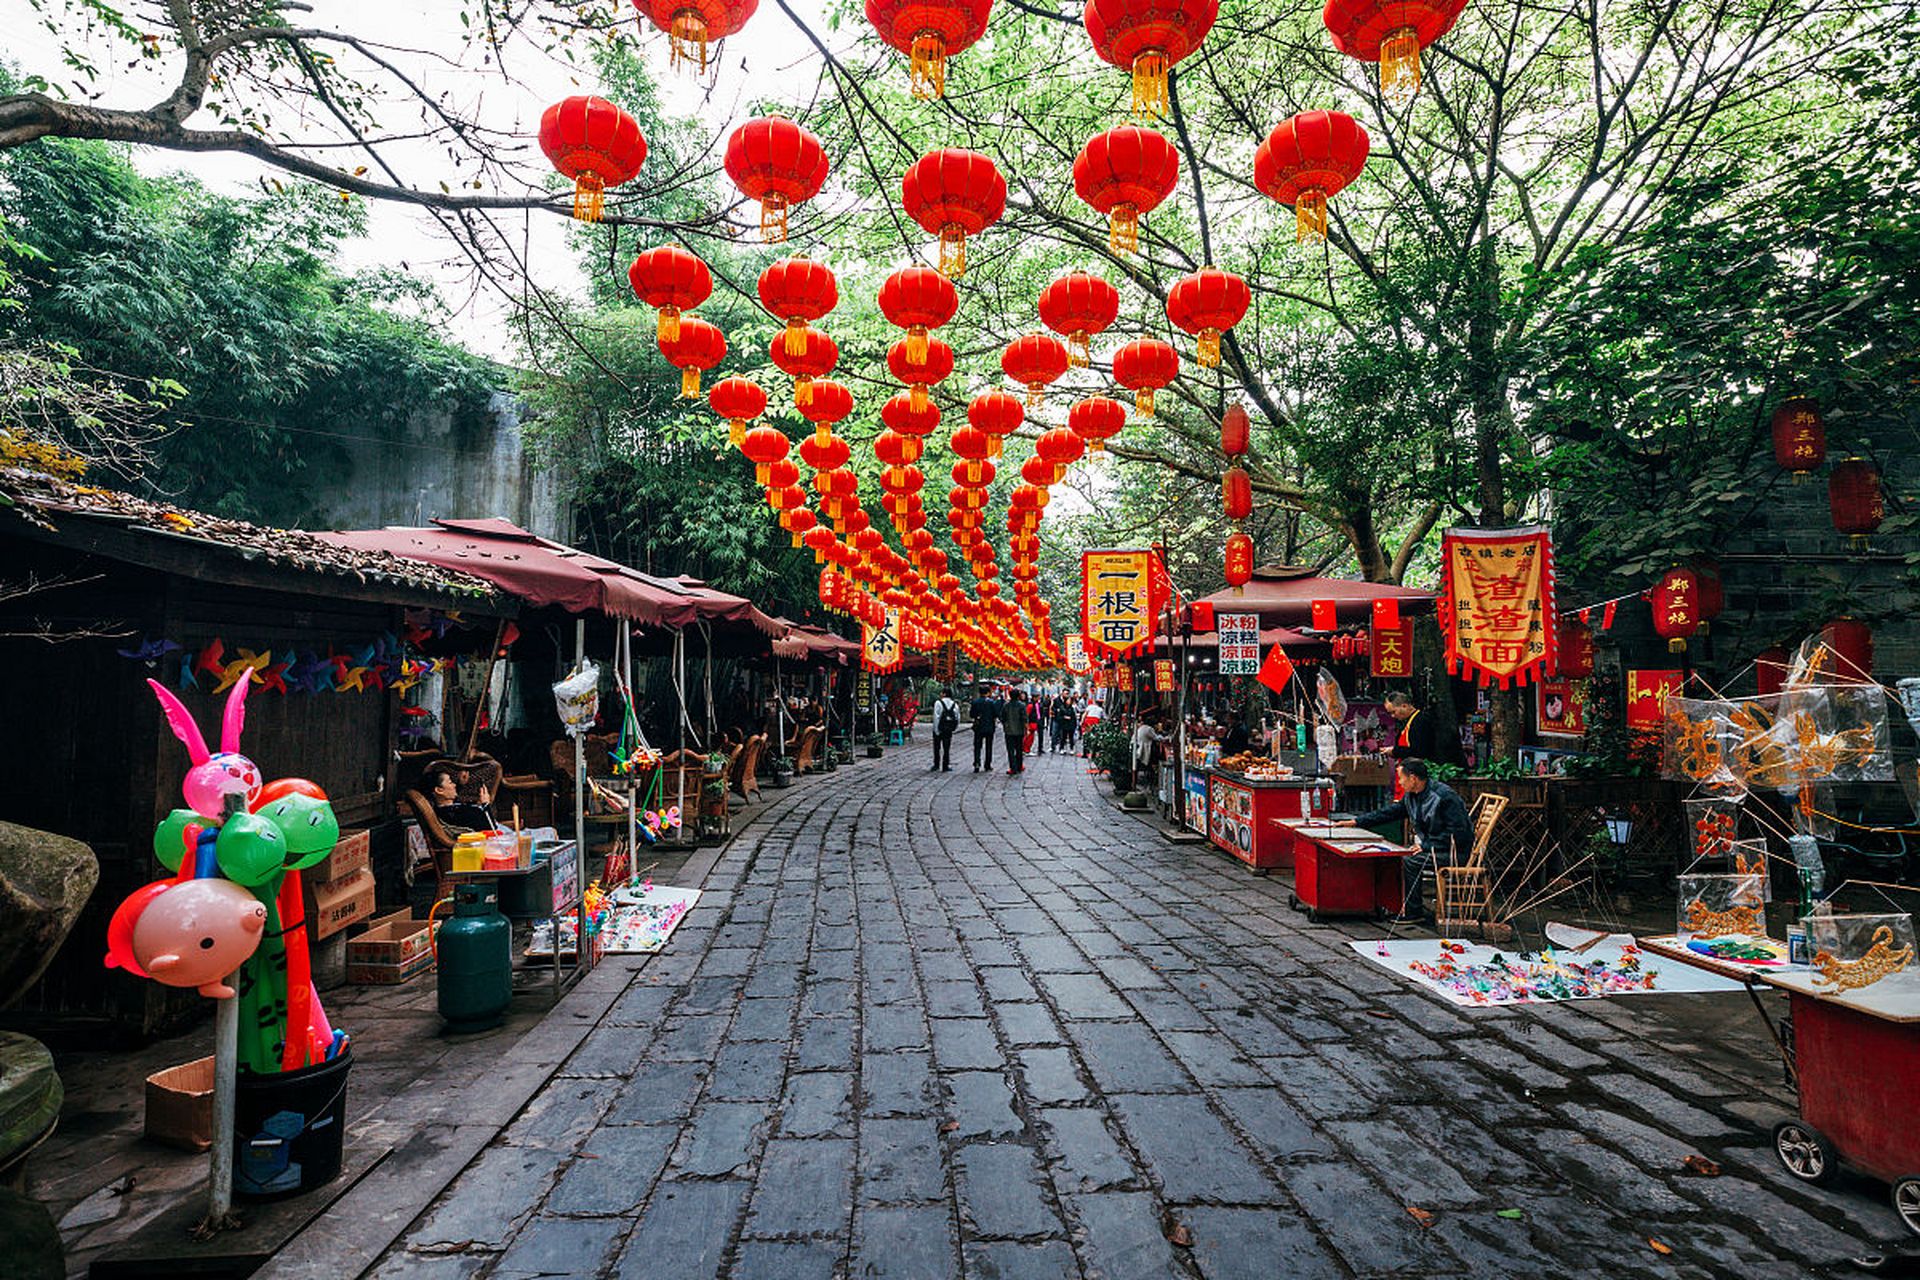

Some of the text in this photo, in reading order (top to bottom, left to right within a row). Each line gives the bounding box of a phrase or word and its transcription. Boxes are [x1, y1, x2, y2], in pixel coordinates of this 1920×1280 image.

[1098, 572, 1140, 642] 一根面
[1667, 577, 1691, 625] 郑三炮
[1220, 616, 1257, 630] 冰粉
[1472, 574, 1530, 663] 渣渣面
[1221, 631, 1258, 645] 凉糕
[1221, 646, 1257, 659] 凉面
[1222, 660, 1258, 673] 凉粉
